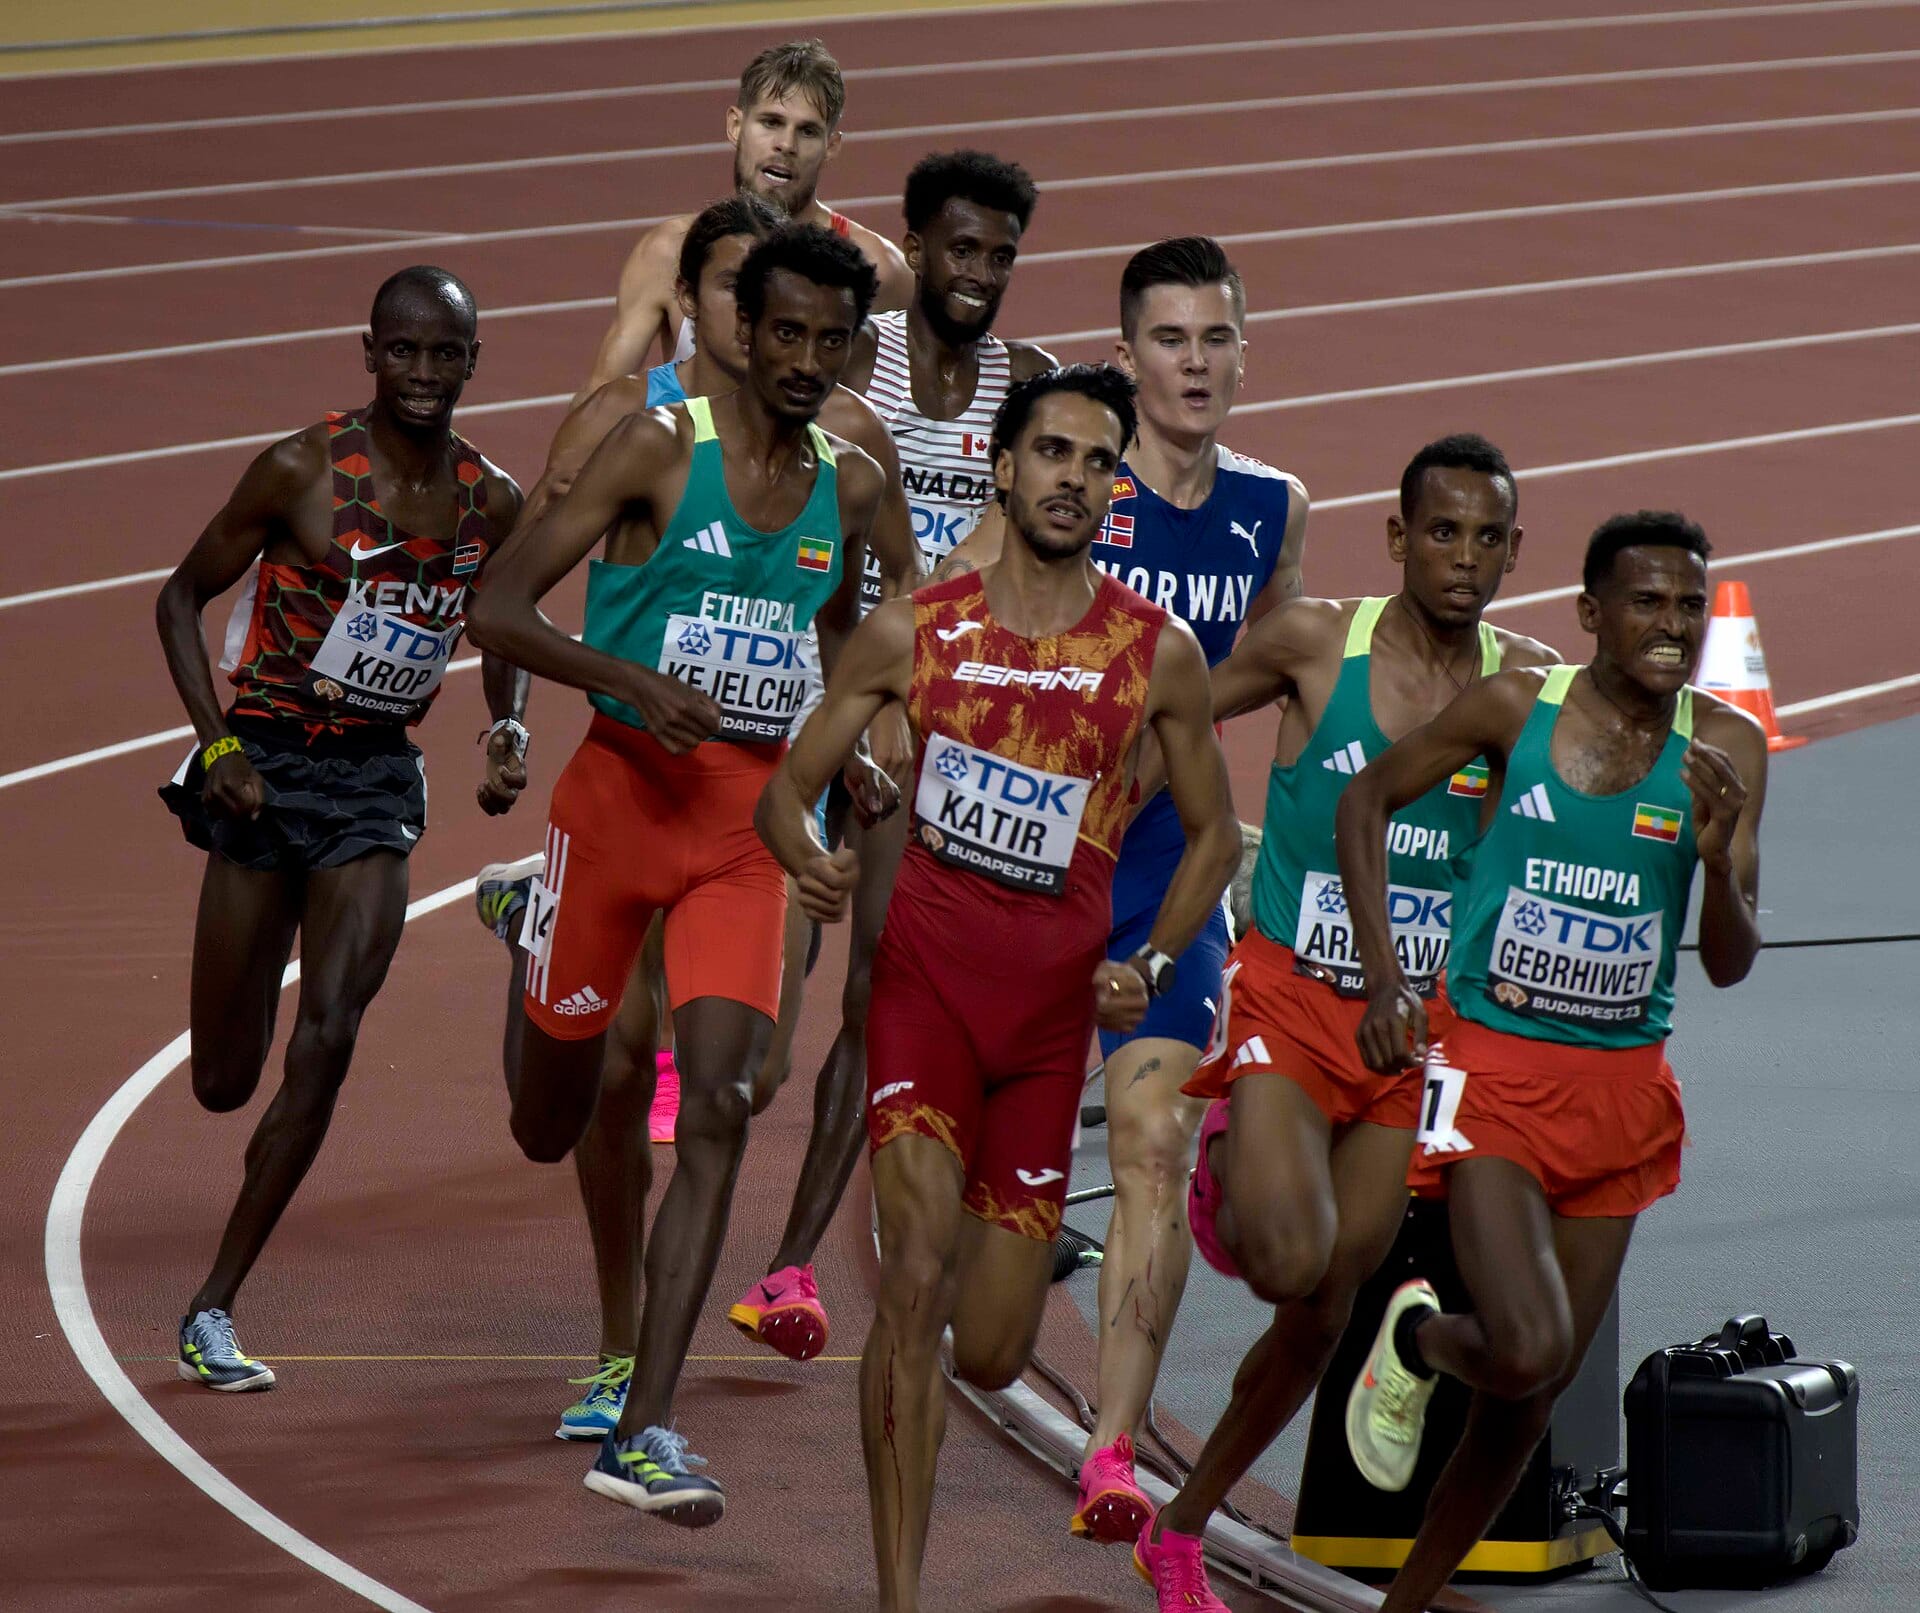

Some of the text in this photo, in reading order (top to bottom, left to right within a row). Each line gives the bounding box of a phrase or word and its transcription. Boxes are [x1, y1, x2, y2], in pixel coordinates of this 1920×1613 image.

[902, 467, 987, 501] NADA
[911, 506, 966, 546] DK
[699, 591, 795, 633] ETHIOPIA
[383, 618, 456, 661] TDK
[714, 627, 806, 669] TDK
[344, 651, 431, 695] KROP
[952, 661, 1105, 692] ESPAÑA
[346, 693, 414, 714] BUDAPES
[720, 716, 785, 737] DAPEST
[970, 754, 1077, 816] TDK
[938, 789, 1047, 857] KATIR
[1387, 822, 1449, 861] IOPIA
[946, 842, 1054, 885] BUDAPEST 23
[1525, 857, 1640, 906] ETHIOPIA
[1389, 891, 1452, 928] DK
[1304, 923, 1451, 972] ARAWI
[1549, 908, 1653, 954] TDK
[1498, 937, 1652, 996] GEBRHIWET
[553, 999, 609, 1016] adidas
[1531, 997, 1623, 1020] BUDAPEST
[1425, 1079, 1443, 1132] 1
